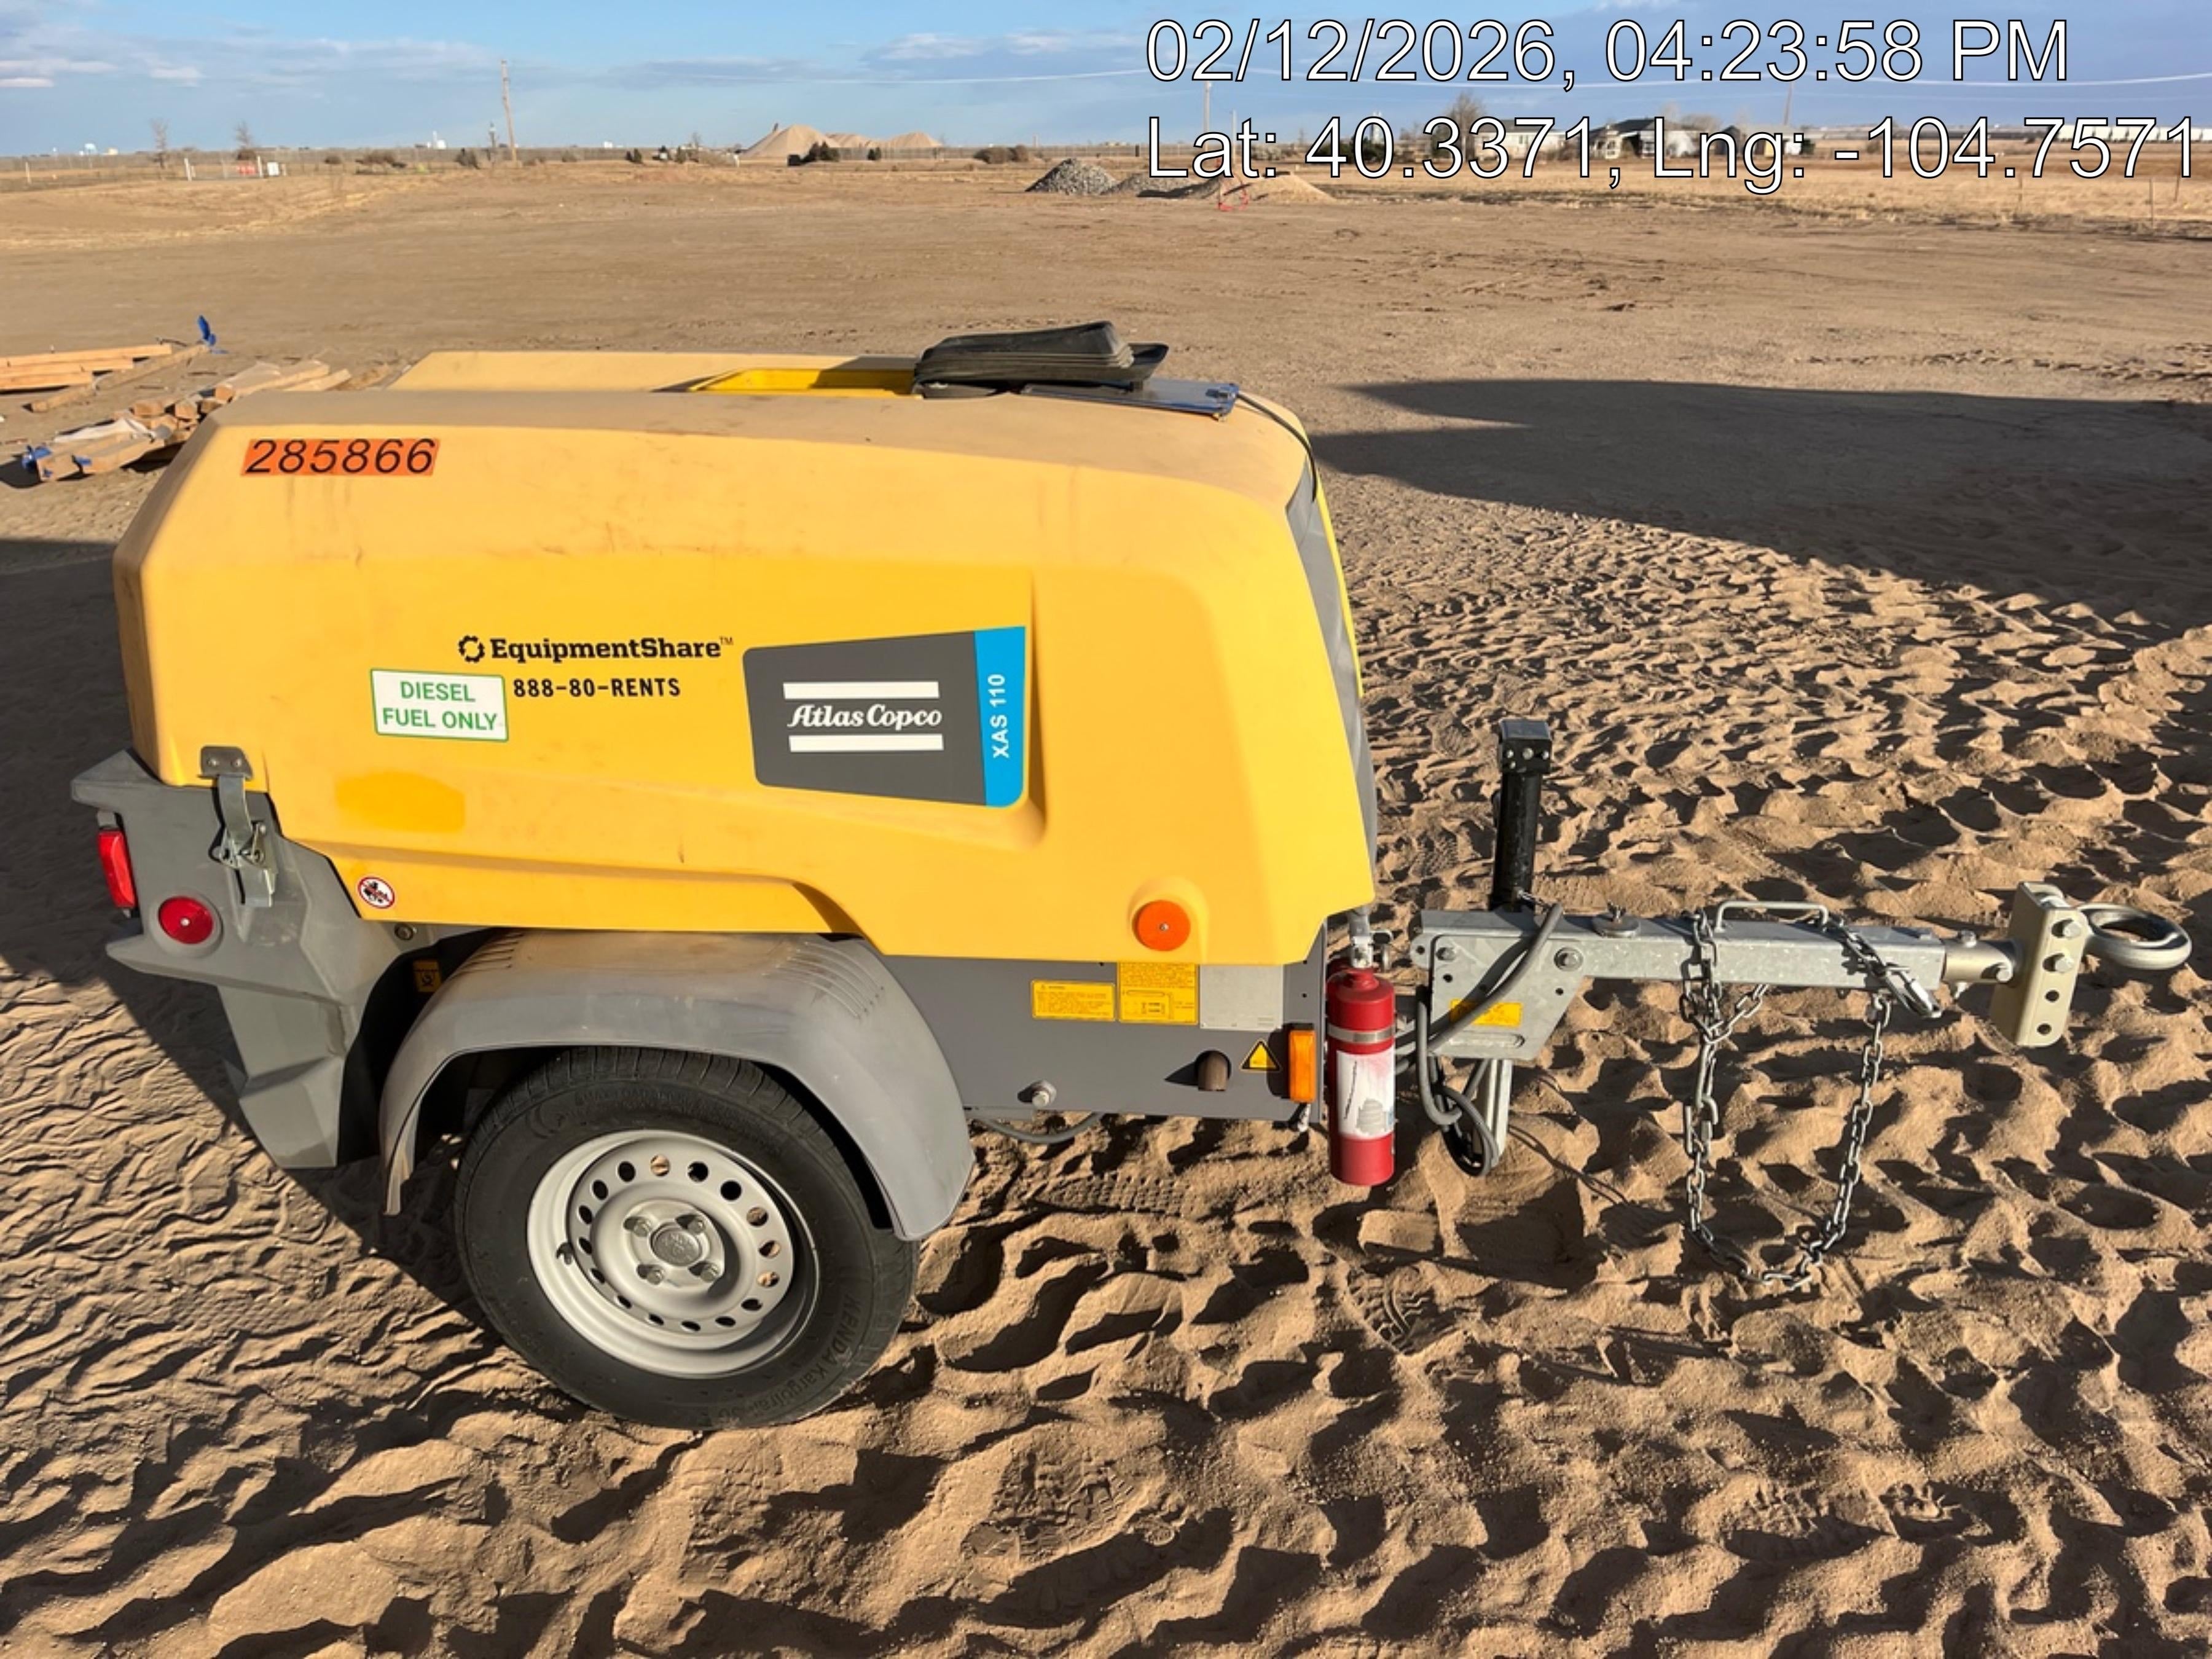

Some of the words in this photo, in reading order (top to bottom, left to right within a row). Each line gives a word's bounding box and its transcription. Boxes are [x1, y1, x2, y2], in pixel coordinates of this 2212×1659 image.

[245, 437, 436, 474] 285866
[400, 681, 476, 703] DIESEL
[513, 678, 681, 698] 888-80-RENTS
[987, 673, 1006, 709] 110
[382, 707, 436, 728] FUEL
[442, 710, 498, 731] ONLY
[786, 704, 865, 728] Atlas
[866, 704, 943, 731] Copco
[989, 714, 1010, 758] XAS
[822, 1292, 862, 1368] KENDA
